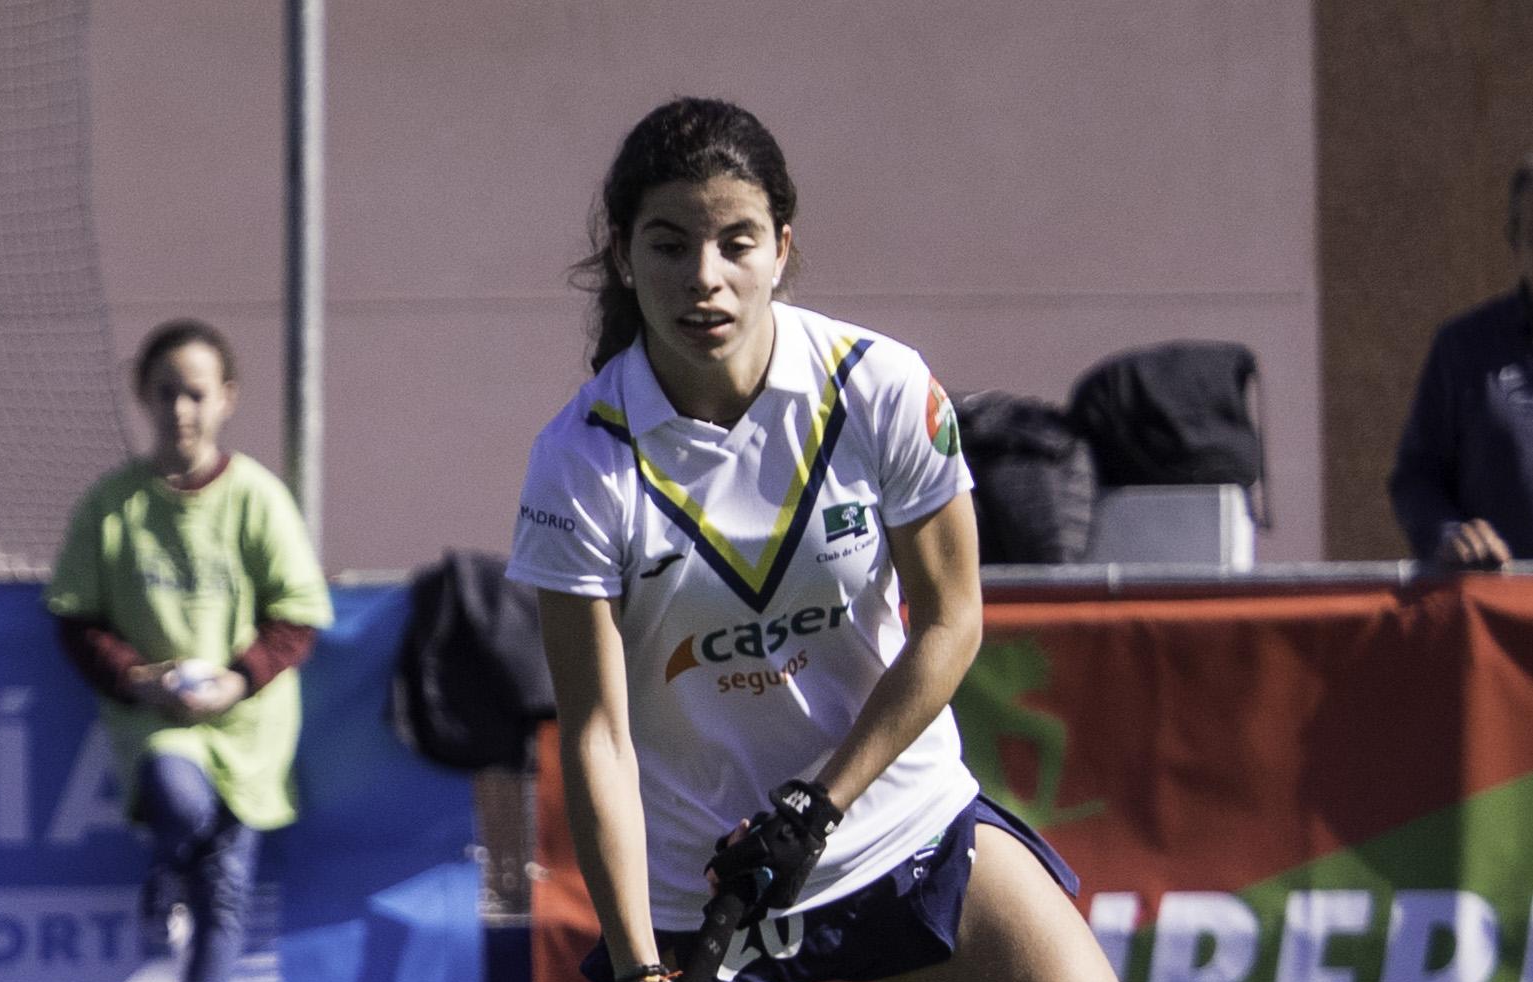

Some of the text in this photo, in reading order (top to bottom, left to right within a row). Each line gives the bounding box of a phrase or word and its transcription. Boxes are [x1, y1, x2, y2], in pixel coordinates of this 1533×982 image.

[518, 505, 575, 533] MADRID
[816, 551, 840, 563] Club
[842, 547, 852, 557] de
[701, 602, 851, 663] caser
[718, 650, 808, 695] seguros
